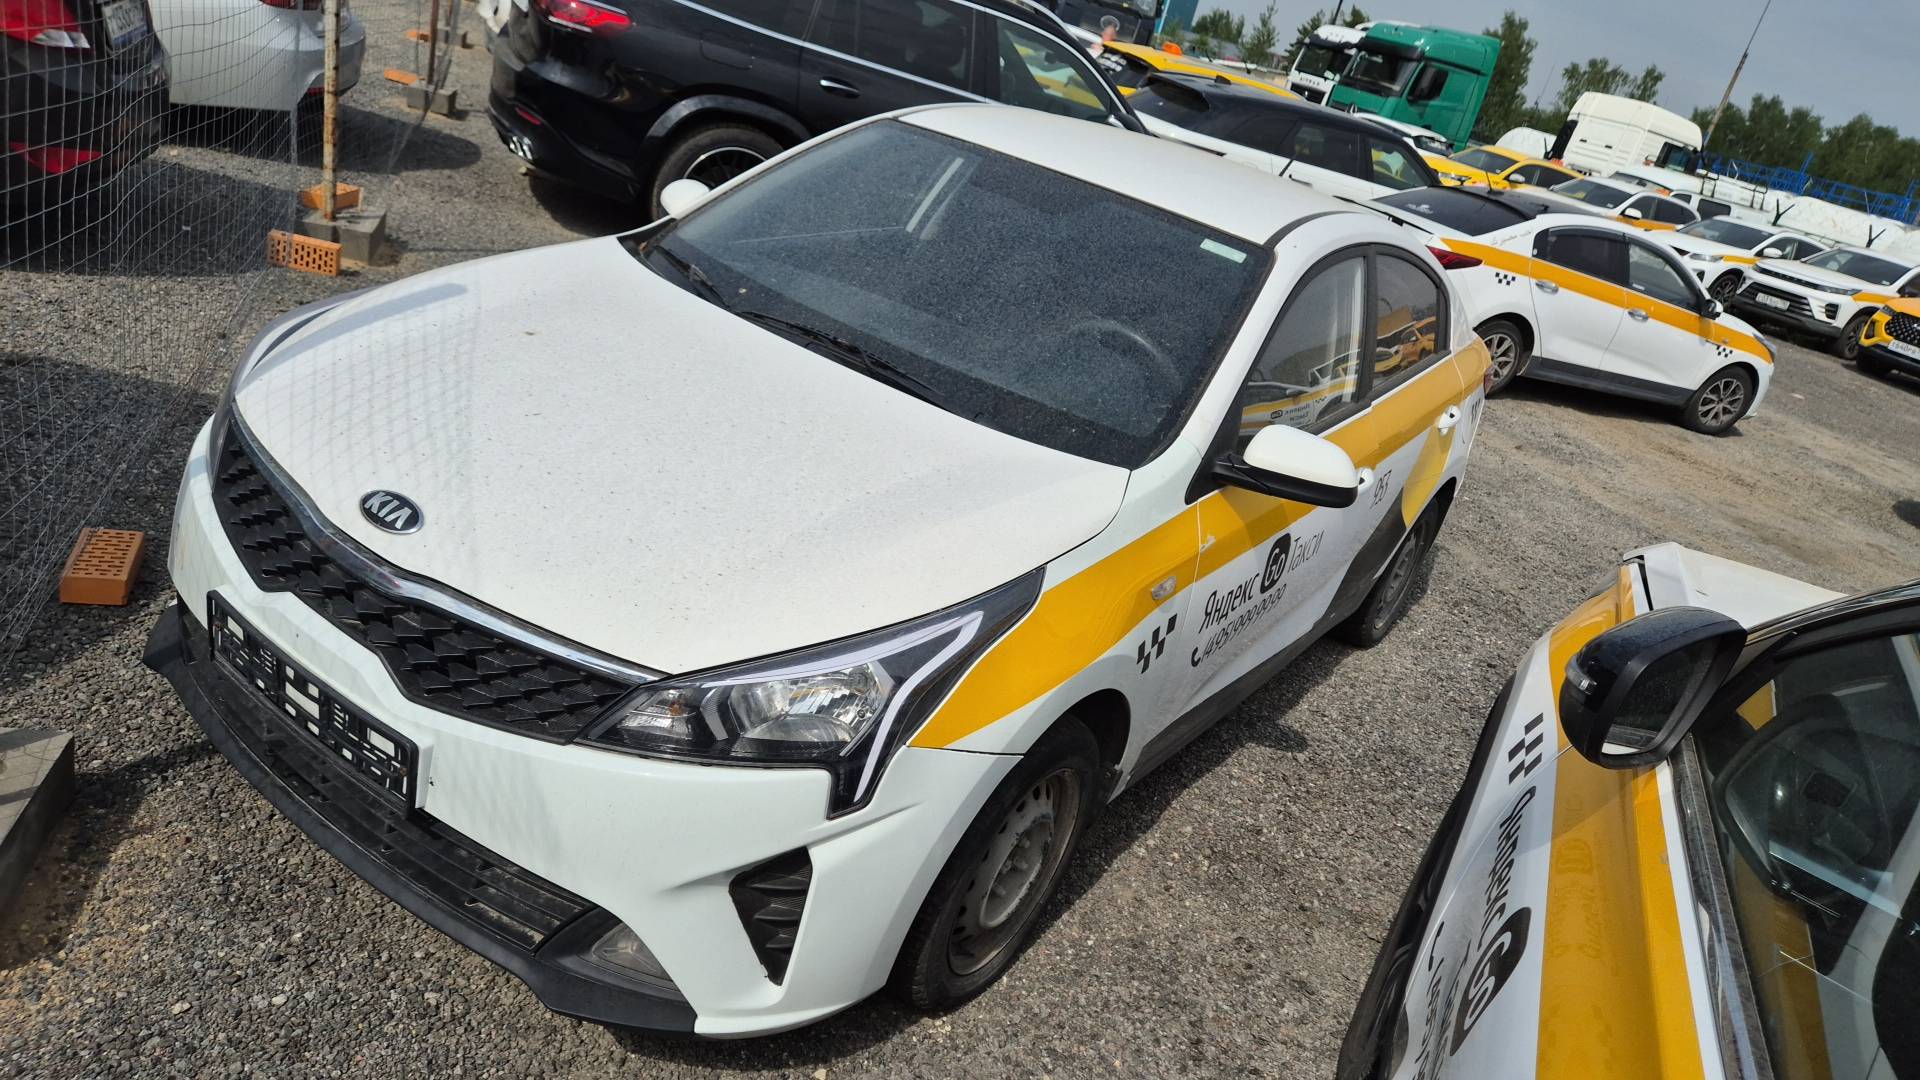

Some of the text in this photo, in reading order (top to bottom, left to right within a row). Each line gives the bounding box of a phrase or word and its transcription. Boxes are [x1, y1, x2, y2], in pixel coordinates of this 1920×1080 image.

[363, 491, 413, 530] KIA
[1198, 572, 1260, 634] Яндекс
[1287, 529, 1325, 573] Такси
